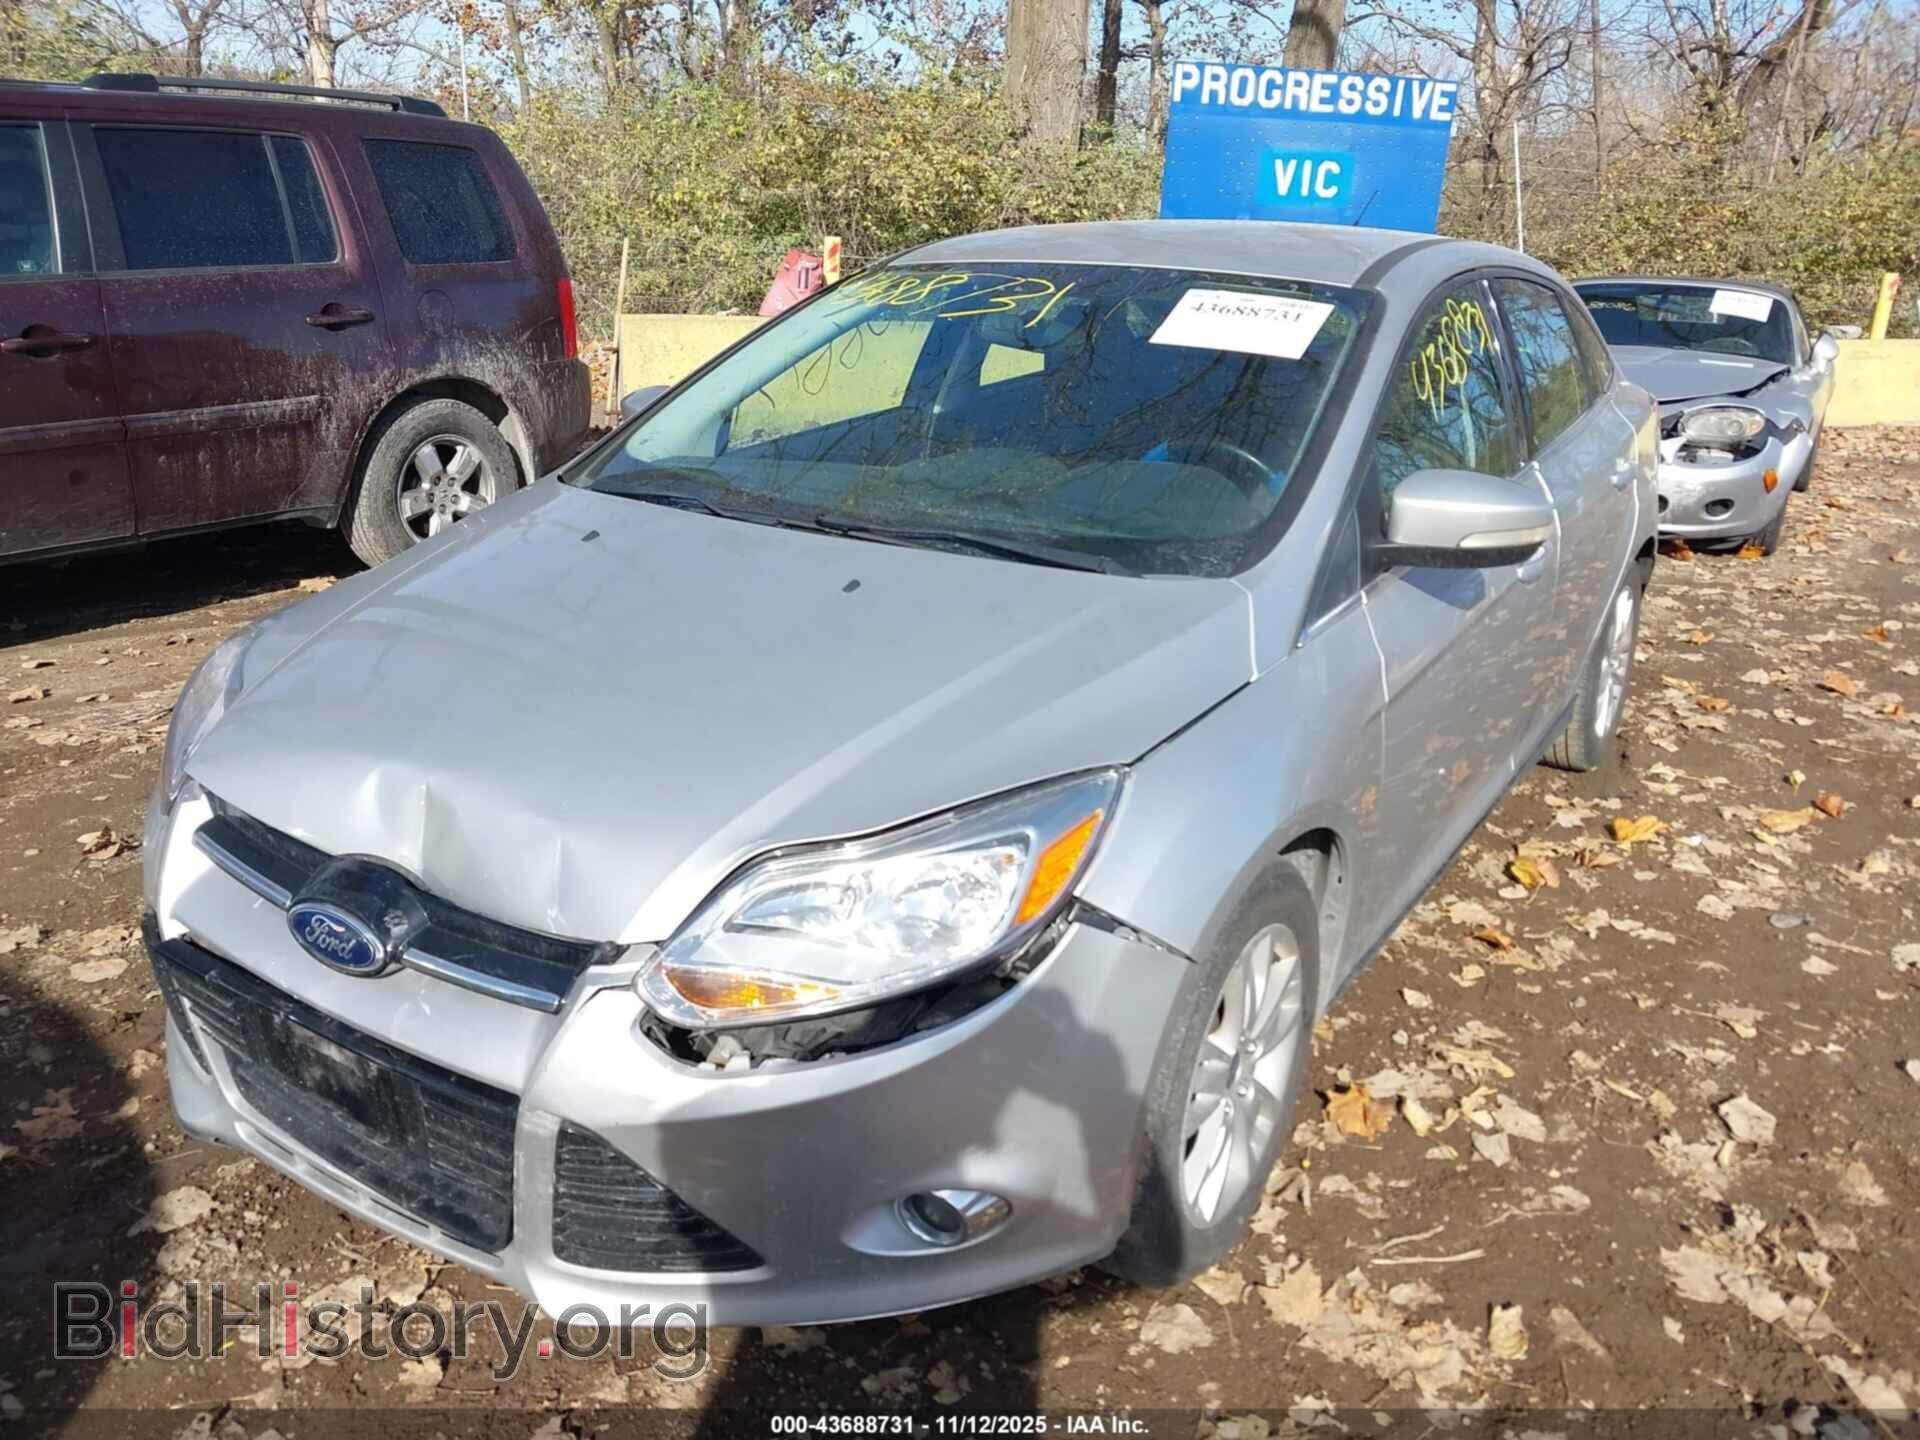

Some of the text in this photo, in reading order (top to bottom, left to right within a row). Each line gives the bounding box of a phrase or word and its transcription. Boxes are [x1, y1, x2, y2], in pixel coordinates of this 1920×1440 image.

[1172, 62, 1458, 121] PROGRESSIVE
[1273, 158, 1341, 199] VIC
[304, 914, 357, 960] Ford
